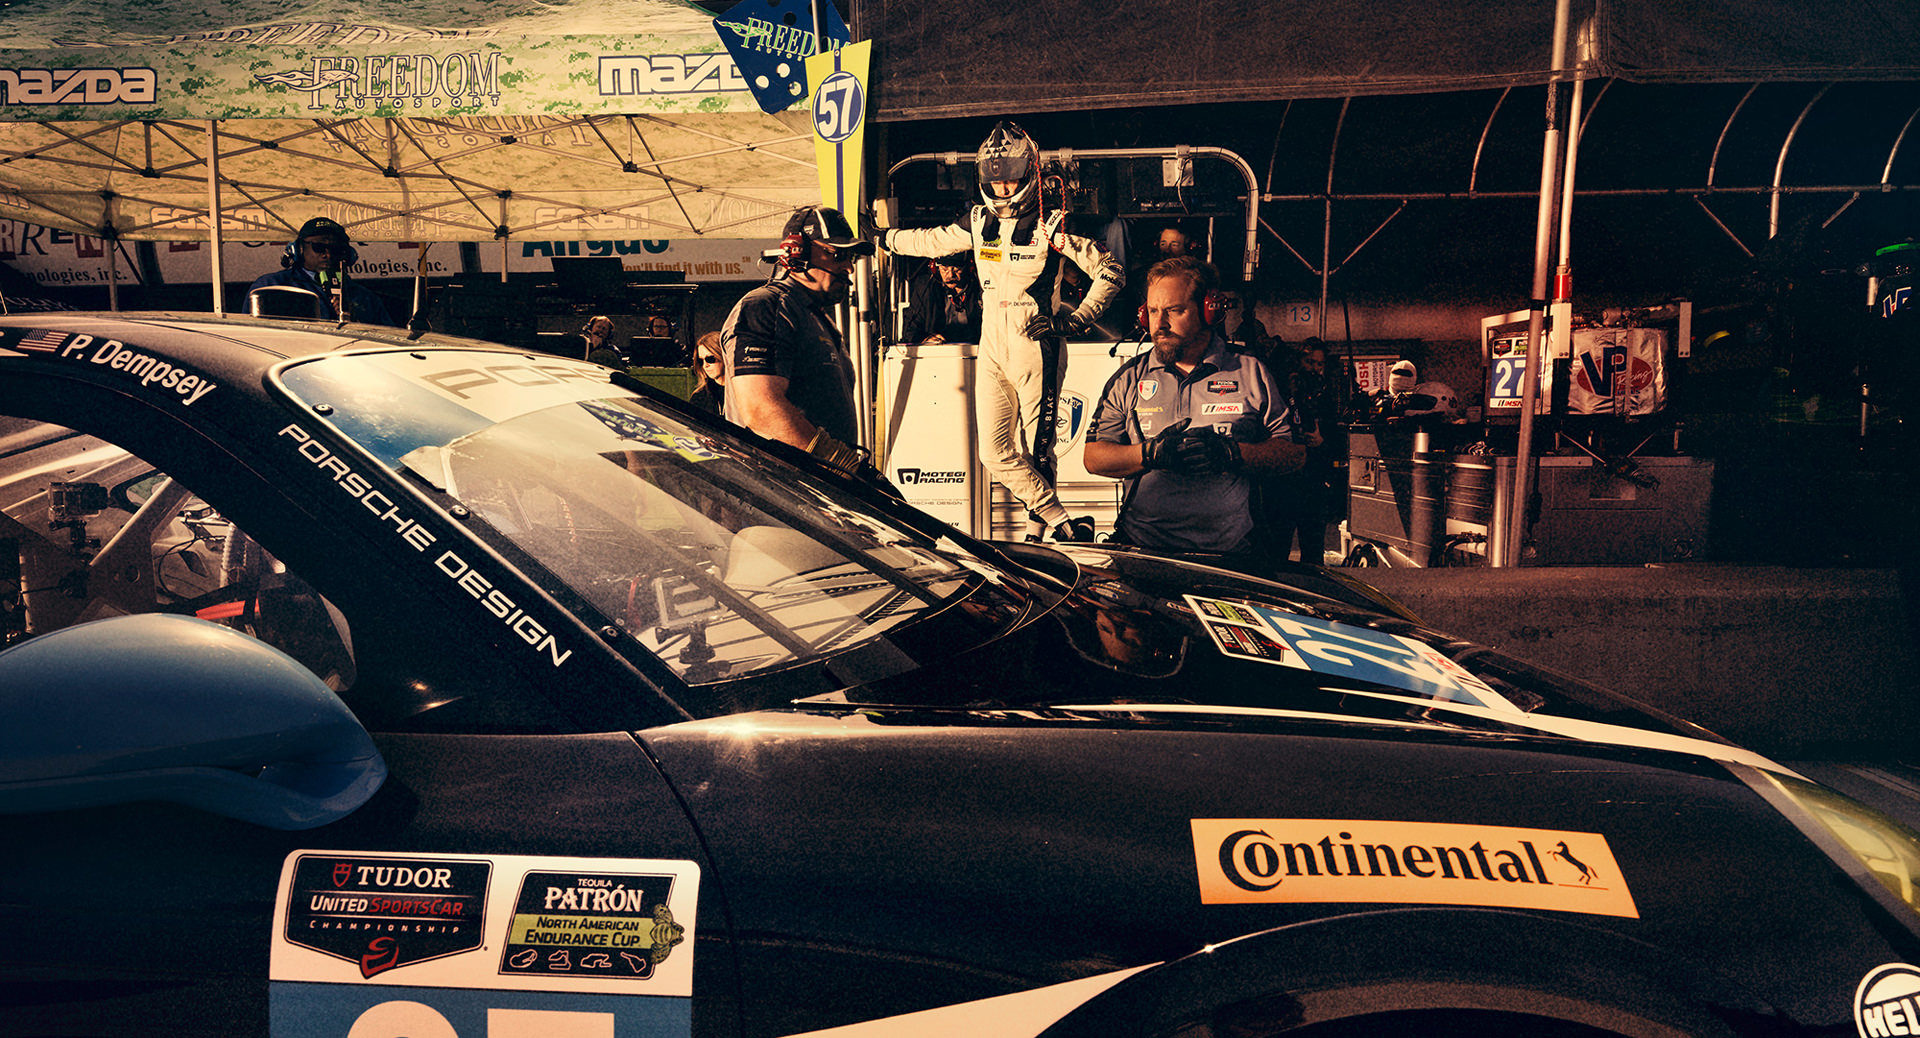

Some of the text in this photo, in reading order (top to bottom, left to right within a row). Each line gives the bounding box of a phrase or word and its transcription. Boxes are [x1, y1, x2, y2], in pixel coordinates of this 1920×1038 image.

[310, 52, 502, 110] FREEDOM
[335, 97, 500, 110] AUTOSPORT
[818, 76, 856, 138] 57
[693, 260, 723, 276] with
[725, 263, 745, 275] us.
[1290, 306, 1311, 322] 13
[61, 334, 218, 406] P. Dempsey
[1580, 346, 1629, 397] VP
[278, 423, 573, 668] PORSCHE DESIGN
[1269, 616, 1461, 690] 27
[1218, 830, 1554, 892] Continental
[356, 866, 452, 889] TUDOR
[577, 878, 613, 888] TEQUILA
[310, 895, 465, 917] UNITED SPORTSCAR
[544, 883, 644, 912] PATRÓN
[309, 920, 461, 934] CHAMPIONSHIP
[536, 915, 640, 932] NORTH AMERICAN
[524, 931, 641, 947] ENDURANCE CUP
[1863, 995, 1920, 1038] HEL
